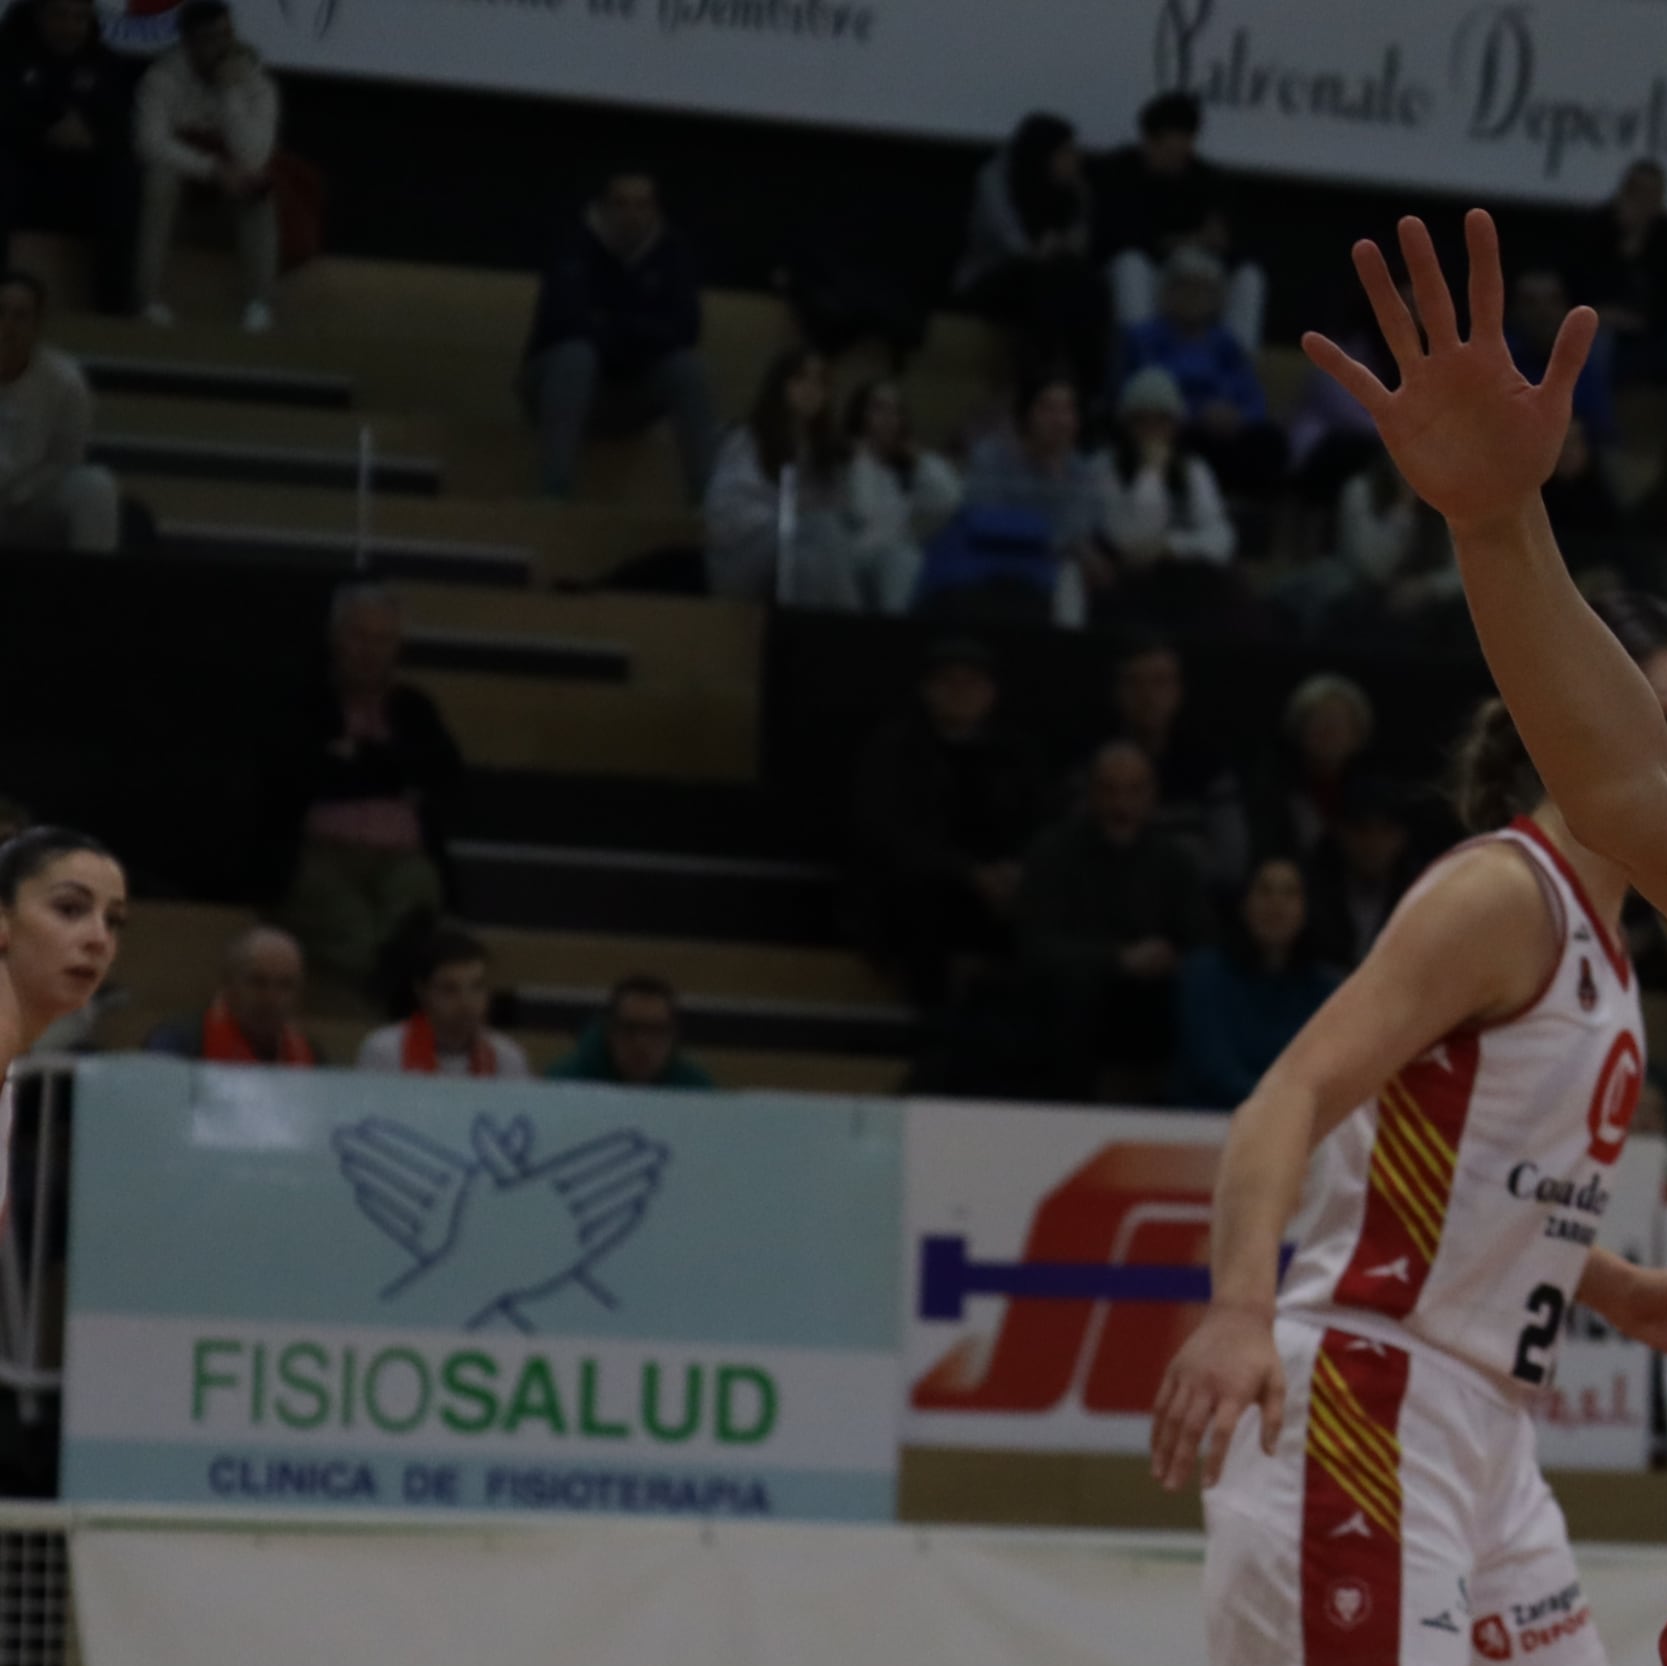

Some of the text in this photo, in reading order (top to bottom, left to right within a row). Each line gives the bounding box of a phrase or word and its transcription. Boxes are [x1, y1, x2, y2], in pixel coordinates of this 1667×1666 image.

[192, 1337, 780, 1446] FISIOSALUD
[208, 1453, 772, 1514] CLINICA DE FISIOTERAPIA
